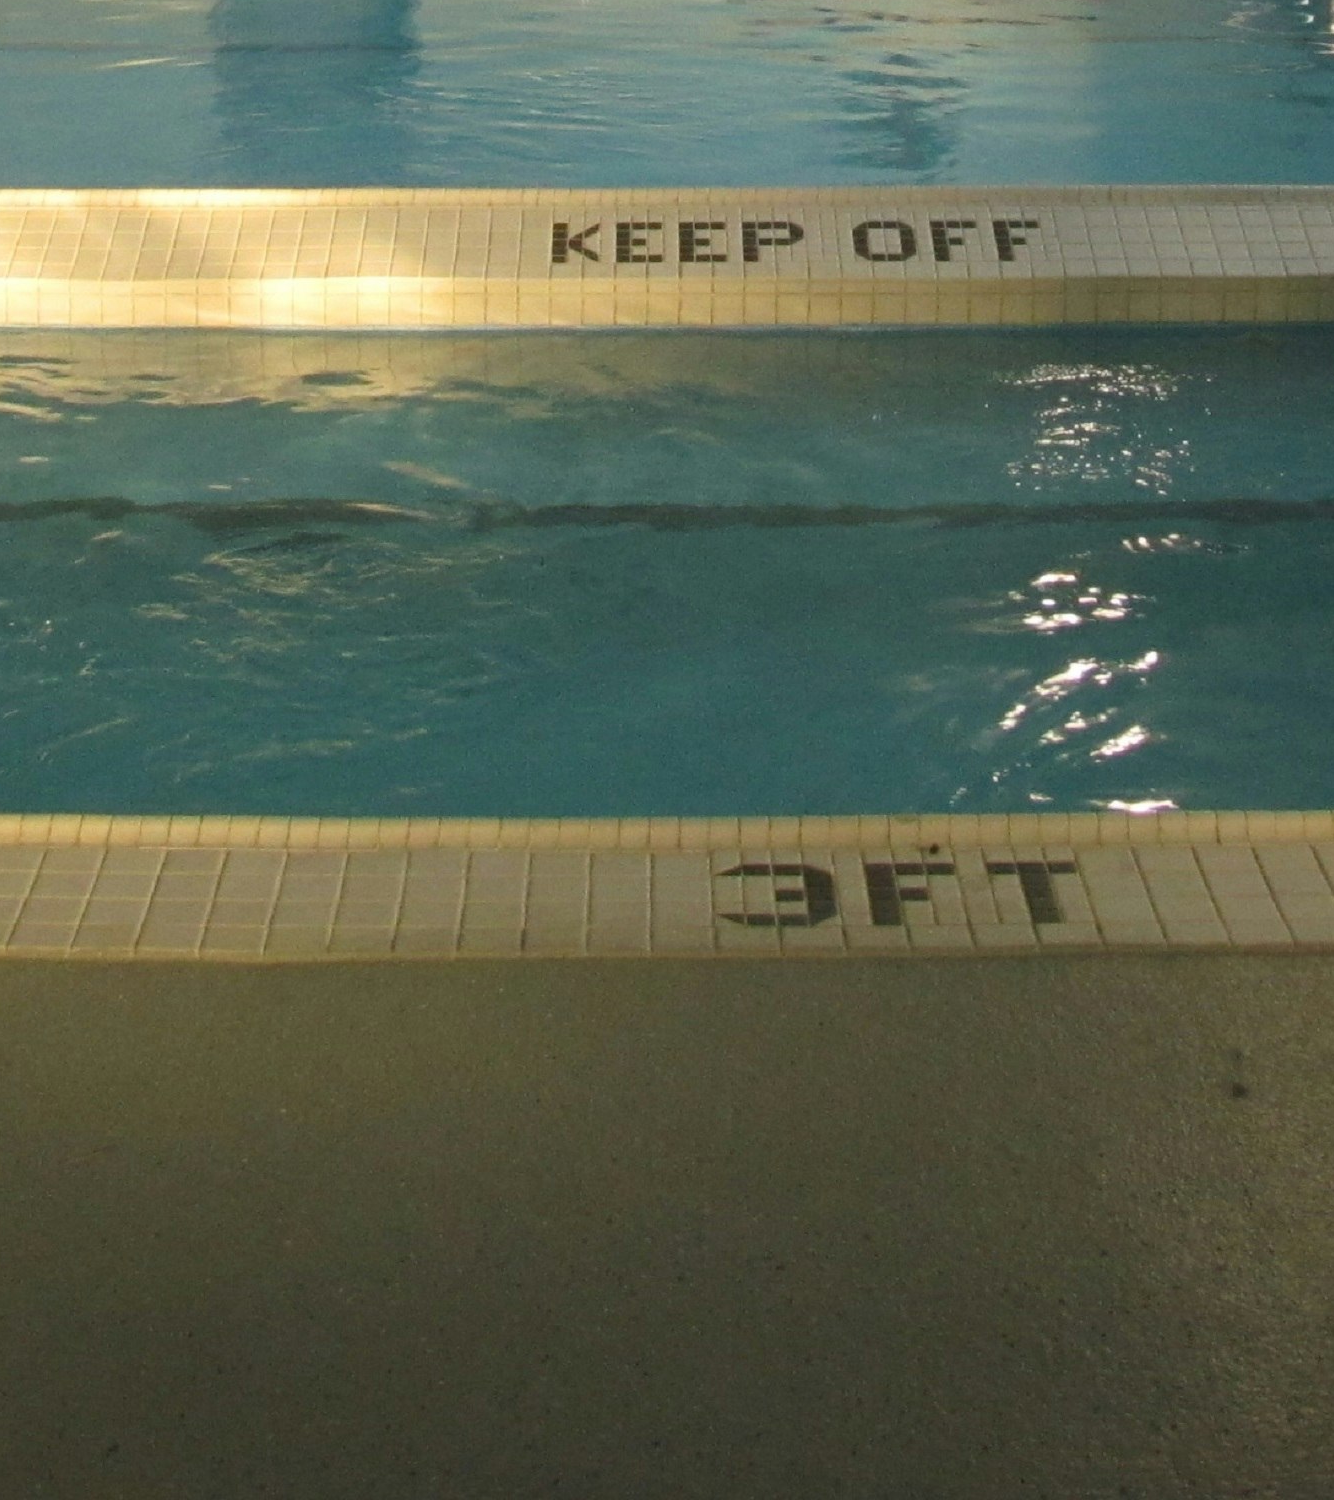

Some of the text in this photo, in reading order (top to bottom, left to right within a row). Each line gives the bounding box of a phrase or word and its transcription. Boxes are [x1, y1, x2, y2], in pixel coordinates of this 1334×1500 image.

[551, 220, 1040, 264] KEEP OFF
[715, 861, 1076, 926] 3FT
